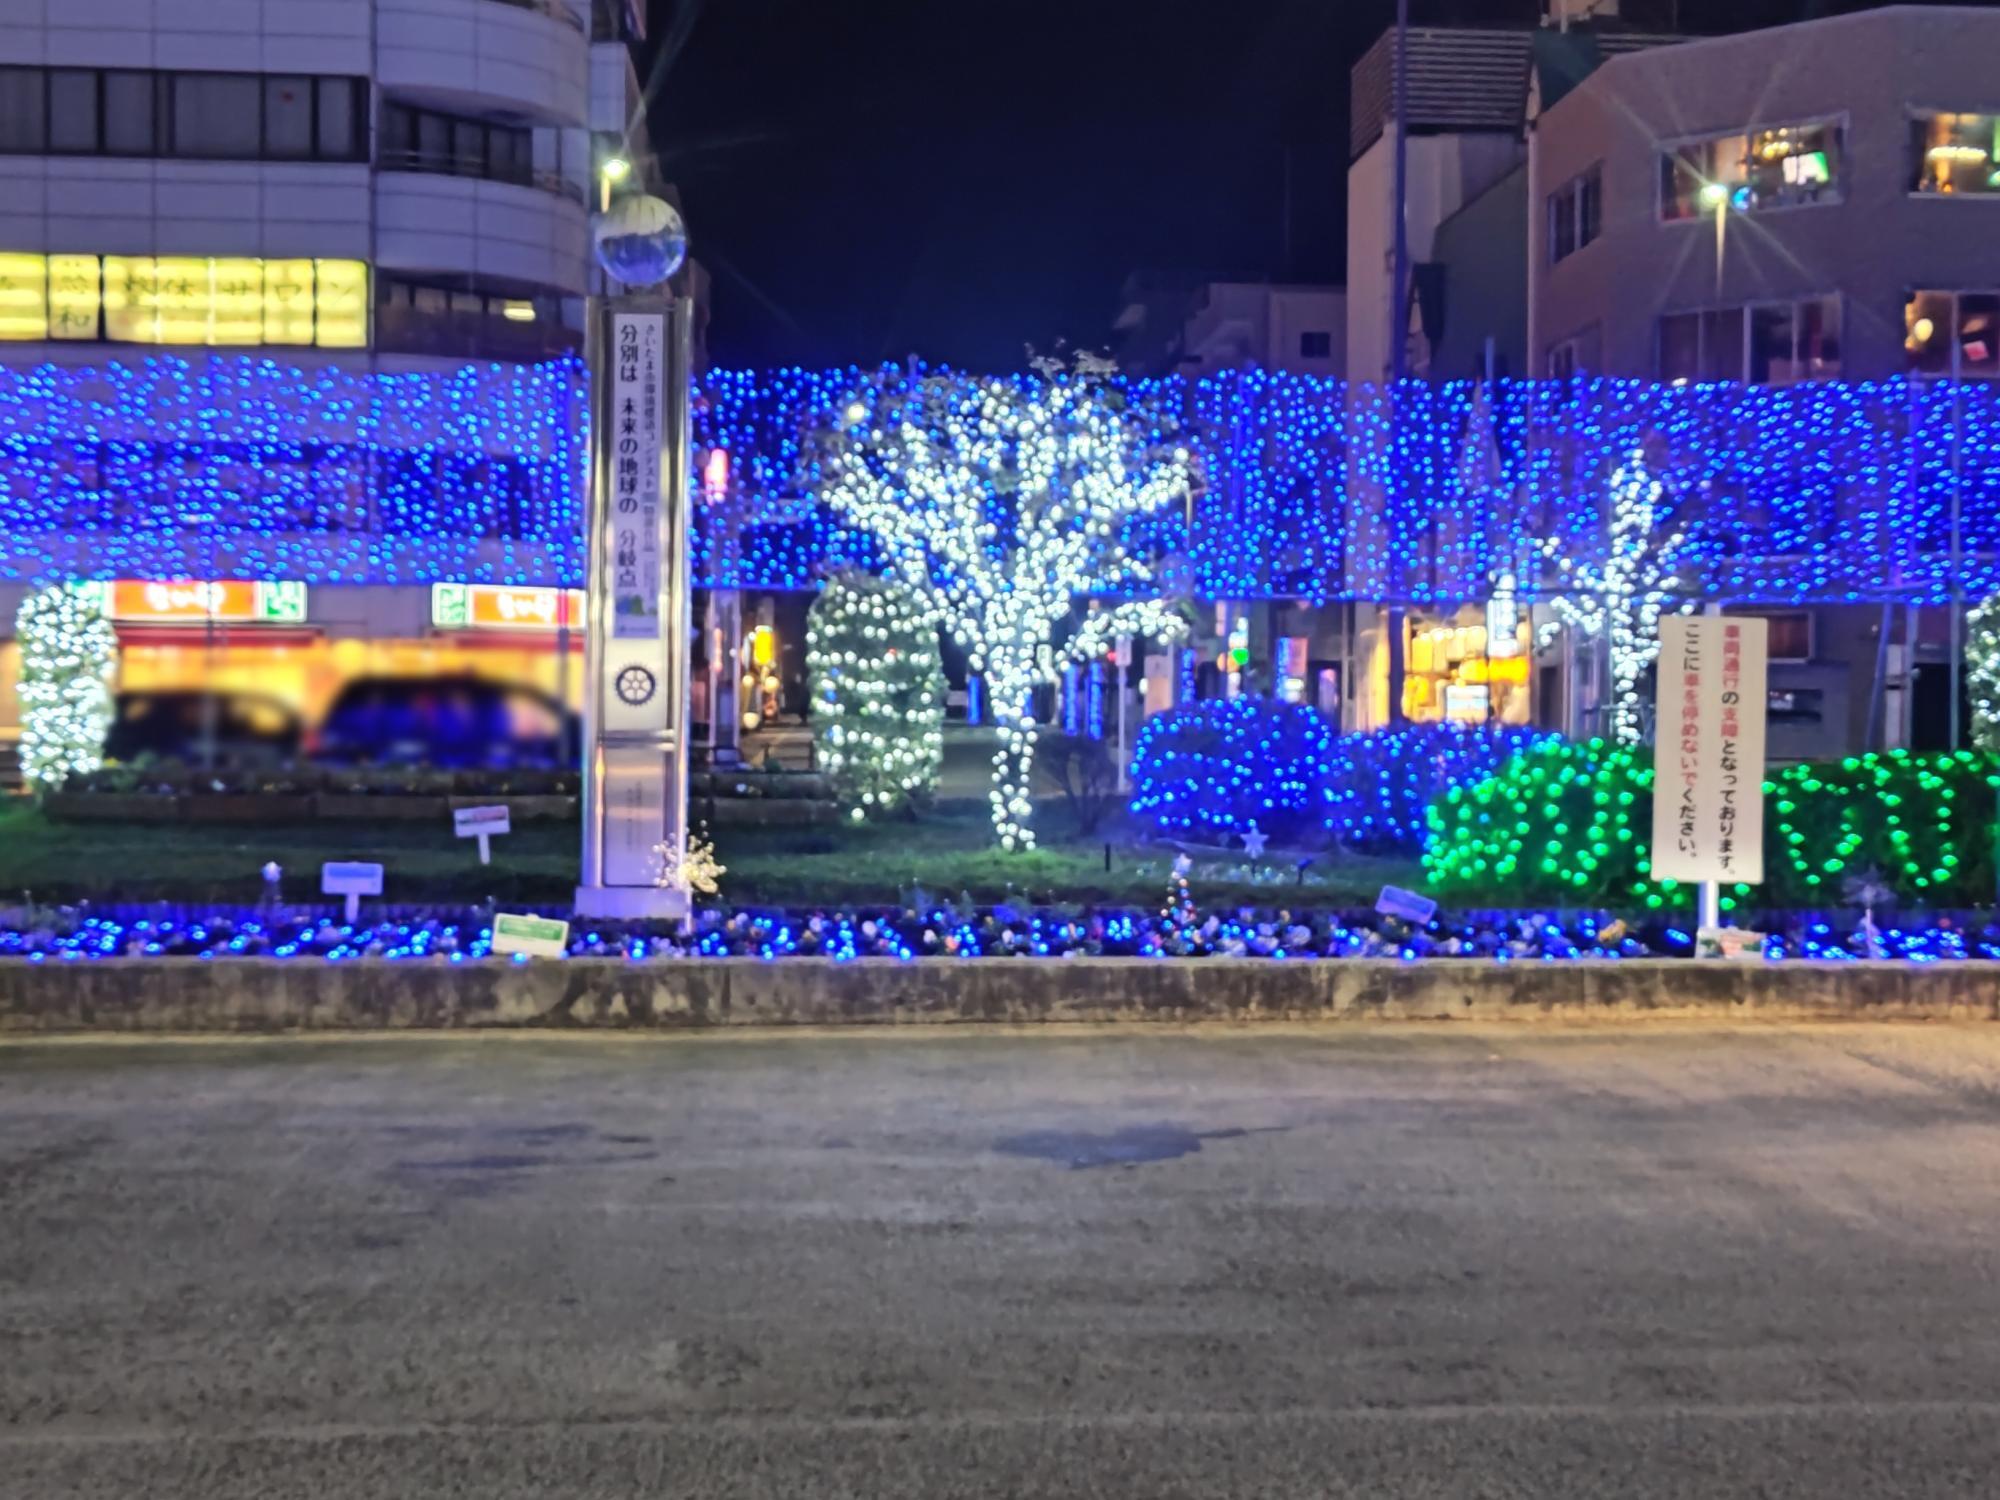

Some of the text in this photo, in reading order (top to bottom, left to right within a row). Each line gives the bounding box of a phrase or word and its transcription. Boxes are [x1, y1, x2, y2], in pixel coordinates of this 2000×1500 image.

[617, 323, 639, 588] 分別は 未来の地球の 分岐点
